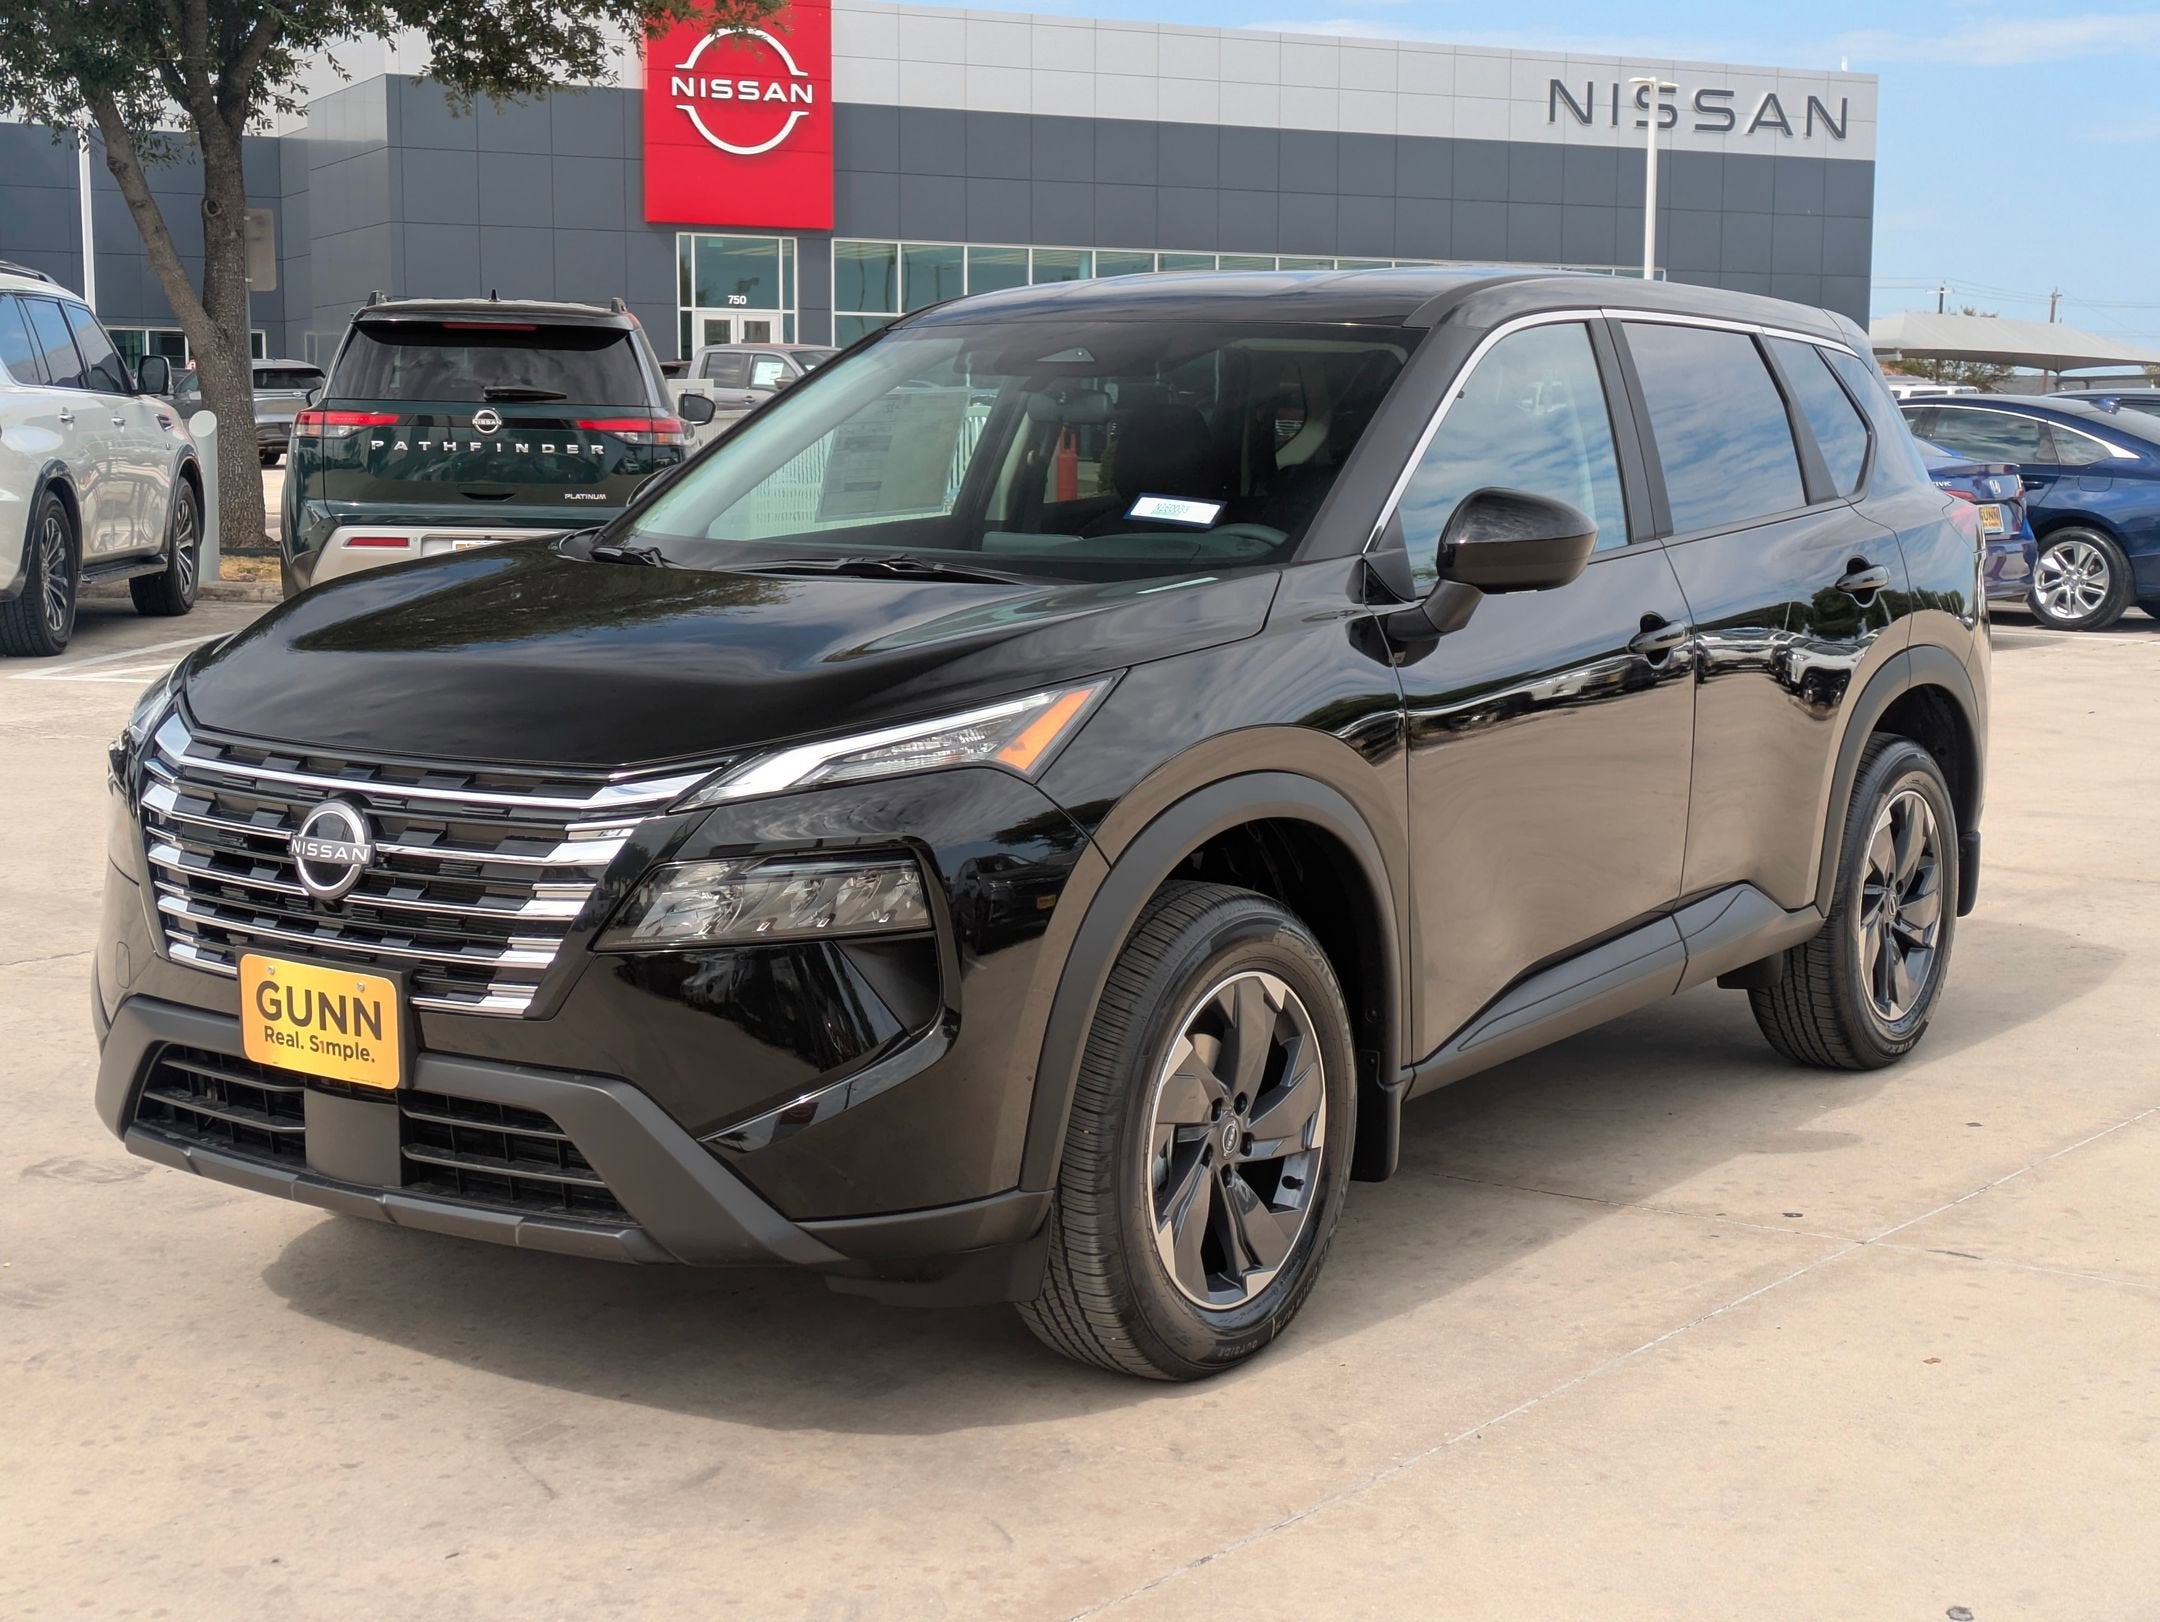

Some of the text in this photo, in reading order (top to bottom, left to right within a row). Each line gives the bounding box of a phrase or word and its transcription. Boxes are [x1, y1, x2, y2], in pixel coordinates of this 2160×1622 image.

[671, 76, 813, 104] NISSAN
[1548, 78, 1849, 140] NISSAN
[727, 294, 747, 305] 750
[472, 418, 502, 426] NISSAN
[370, 440, 604, 455] PATHFINDER
[564, 493, 607, 501] PLATINUM
[291, 839, 368, 862] NISSAN
[256, 980, 382, 1041] GUNN
[264, 1025, 304, 1050] Real.
